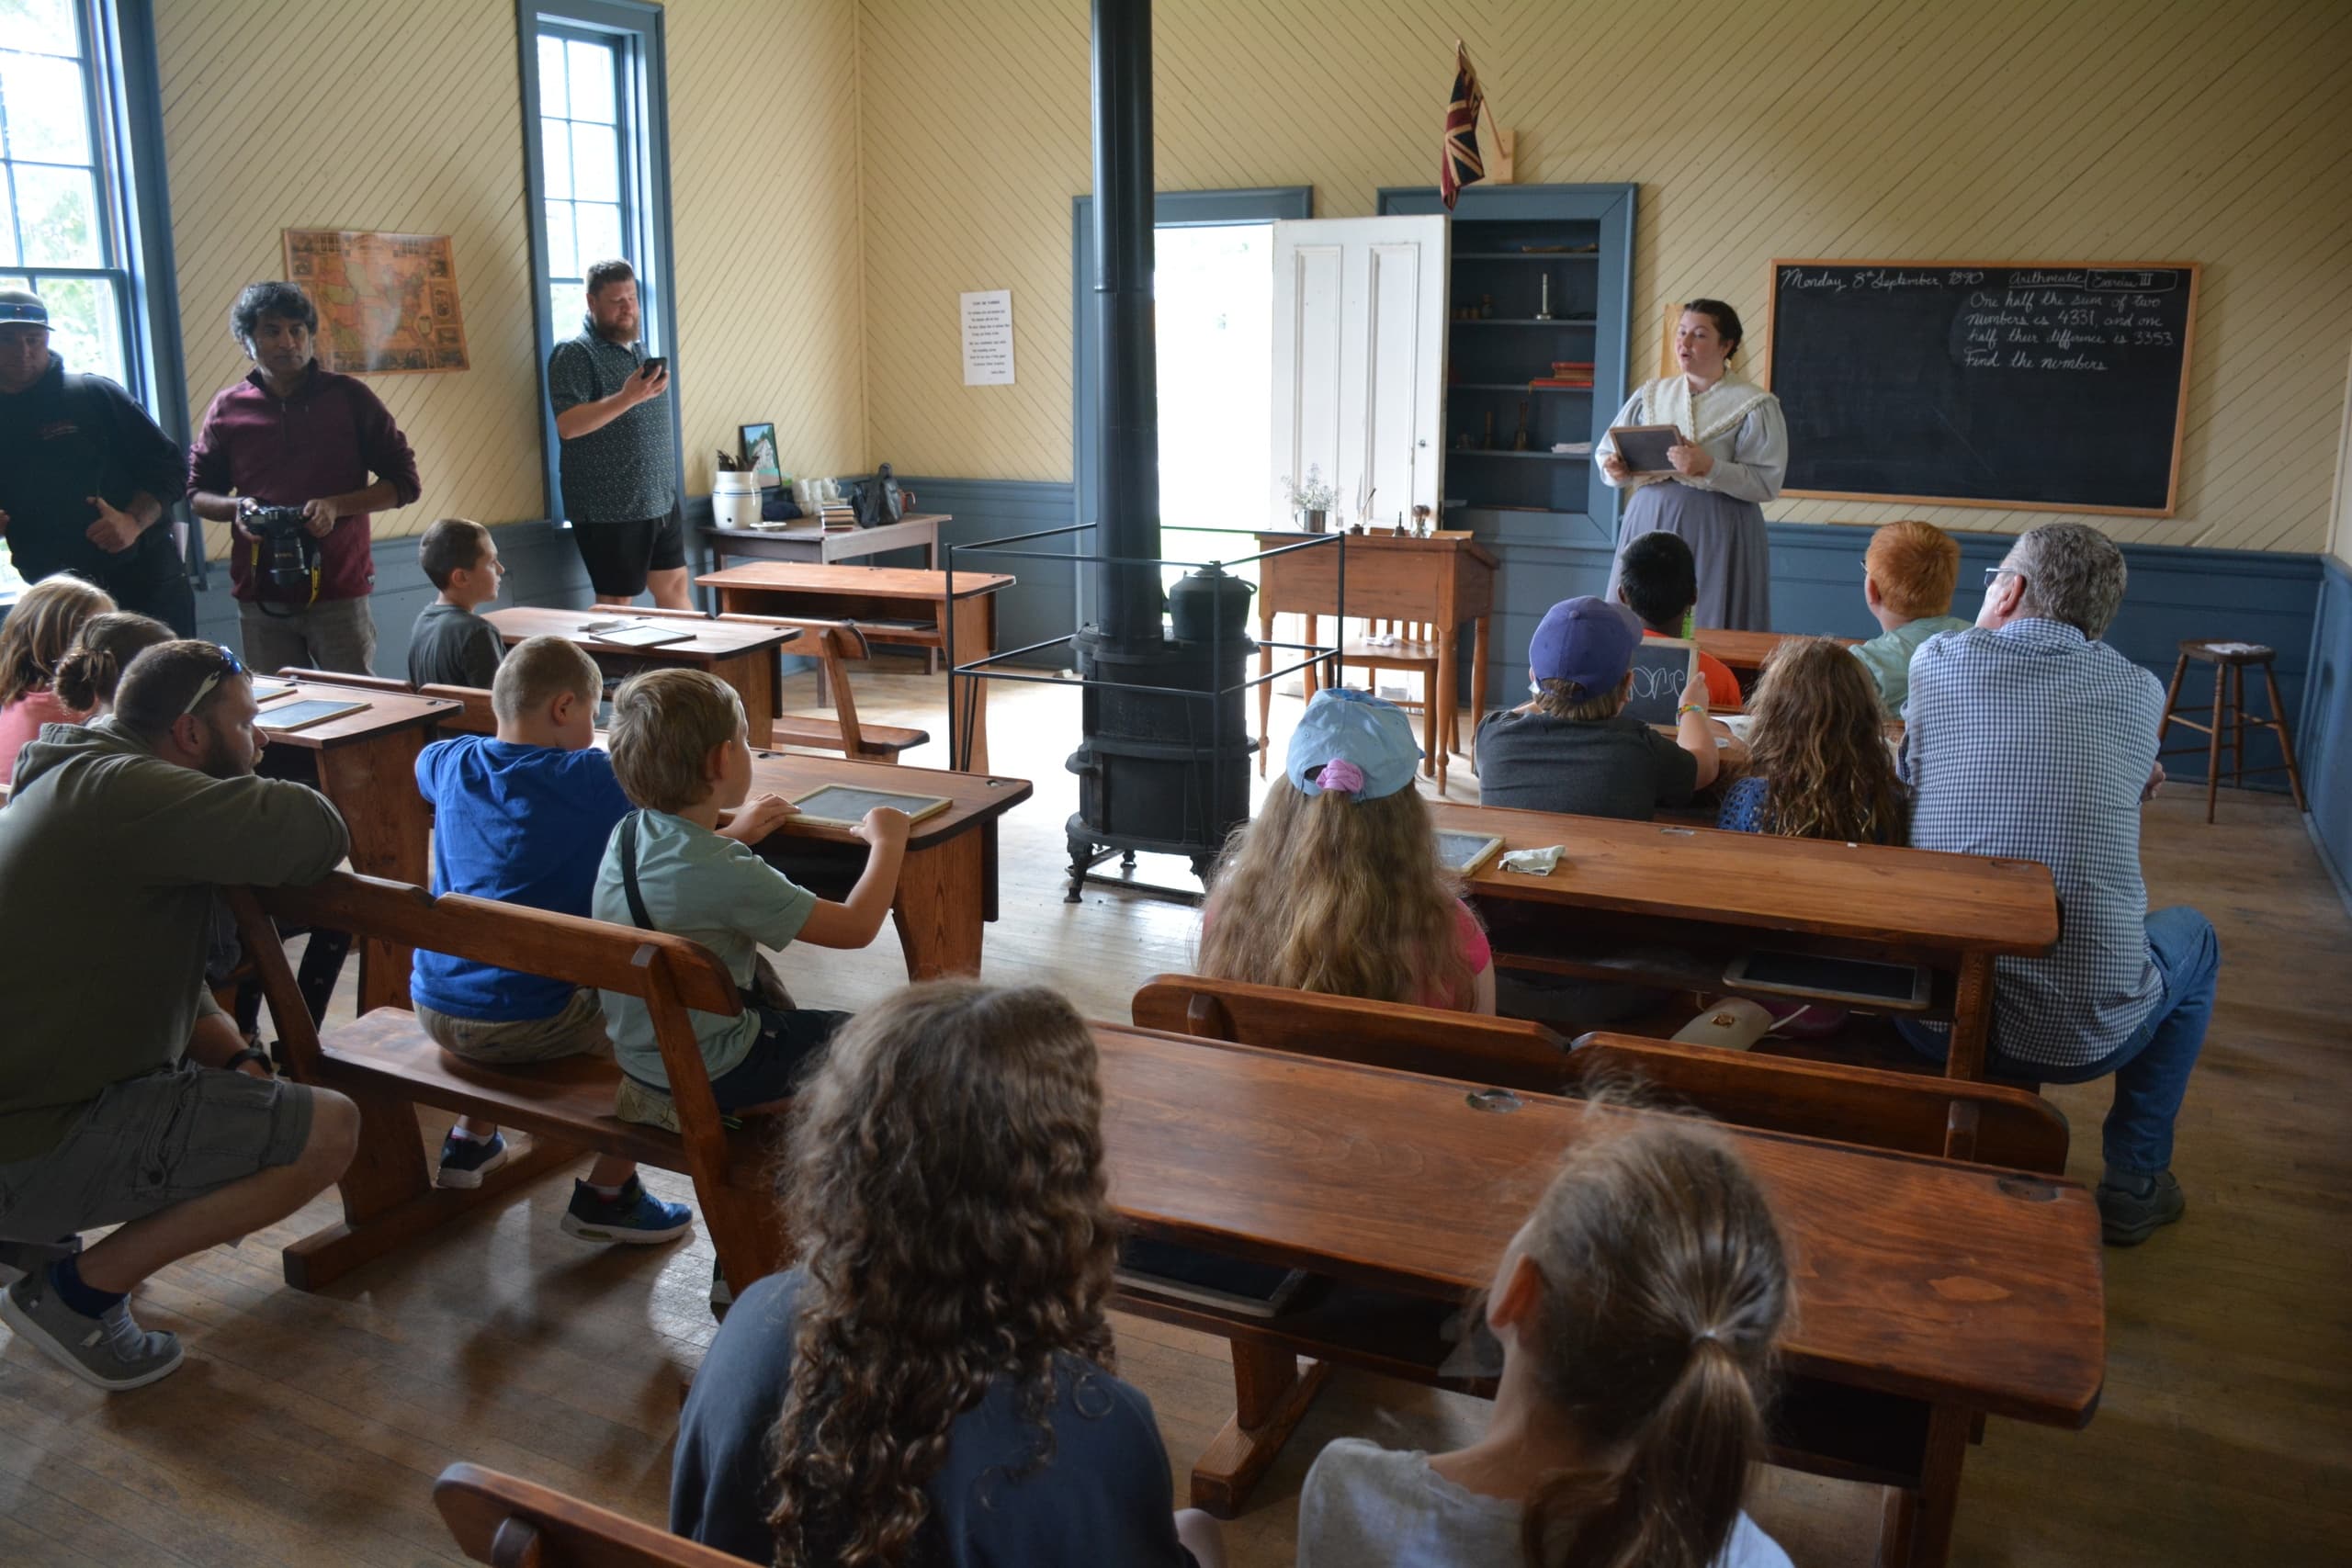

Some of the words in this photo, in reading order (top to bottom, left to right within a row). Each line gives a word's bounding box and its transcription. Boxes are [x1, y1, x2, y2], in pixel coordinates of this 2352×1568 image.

[1781, 268, 1847, 294] Monday
[1970, 292, 1999, 308] One
[2005, 290, 2035, 313] half
[2041, 291, 2065, 306] the
[2070, 295, 2102, 306] sum
[2111, 294, 2128, 313] of
[2132, 294, 2161, 308] two
[1964, 310, 2029, 326] numbers
[2033, 316, 2050, 325] is
[2104, 313, 2134, 327] and
[2138, 317, 2163, 327] one
[1967, 329, 1999, 350] half
[2007, 328, 2039, 344] their
[2046, 329, 2106, 350] difference
[2113, 334, 2129, 344] is
[1963, 346, 2000, 367] Find
[2011, 350, 2035, 368] the
[2041, 353, 2108, 370] numbers
